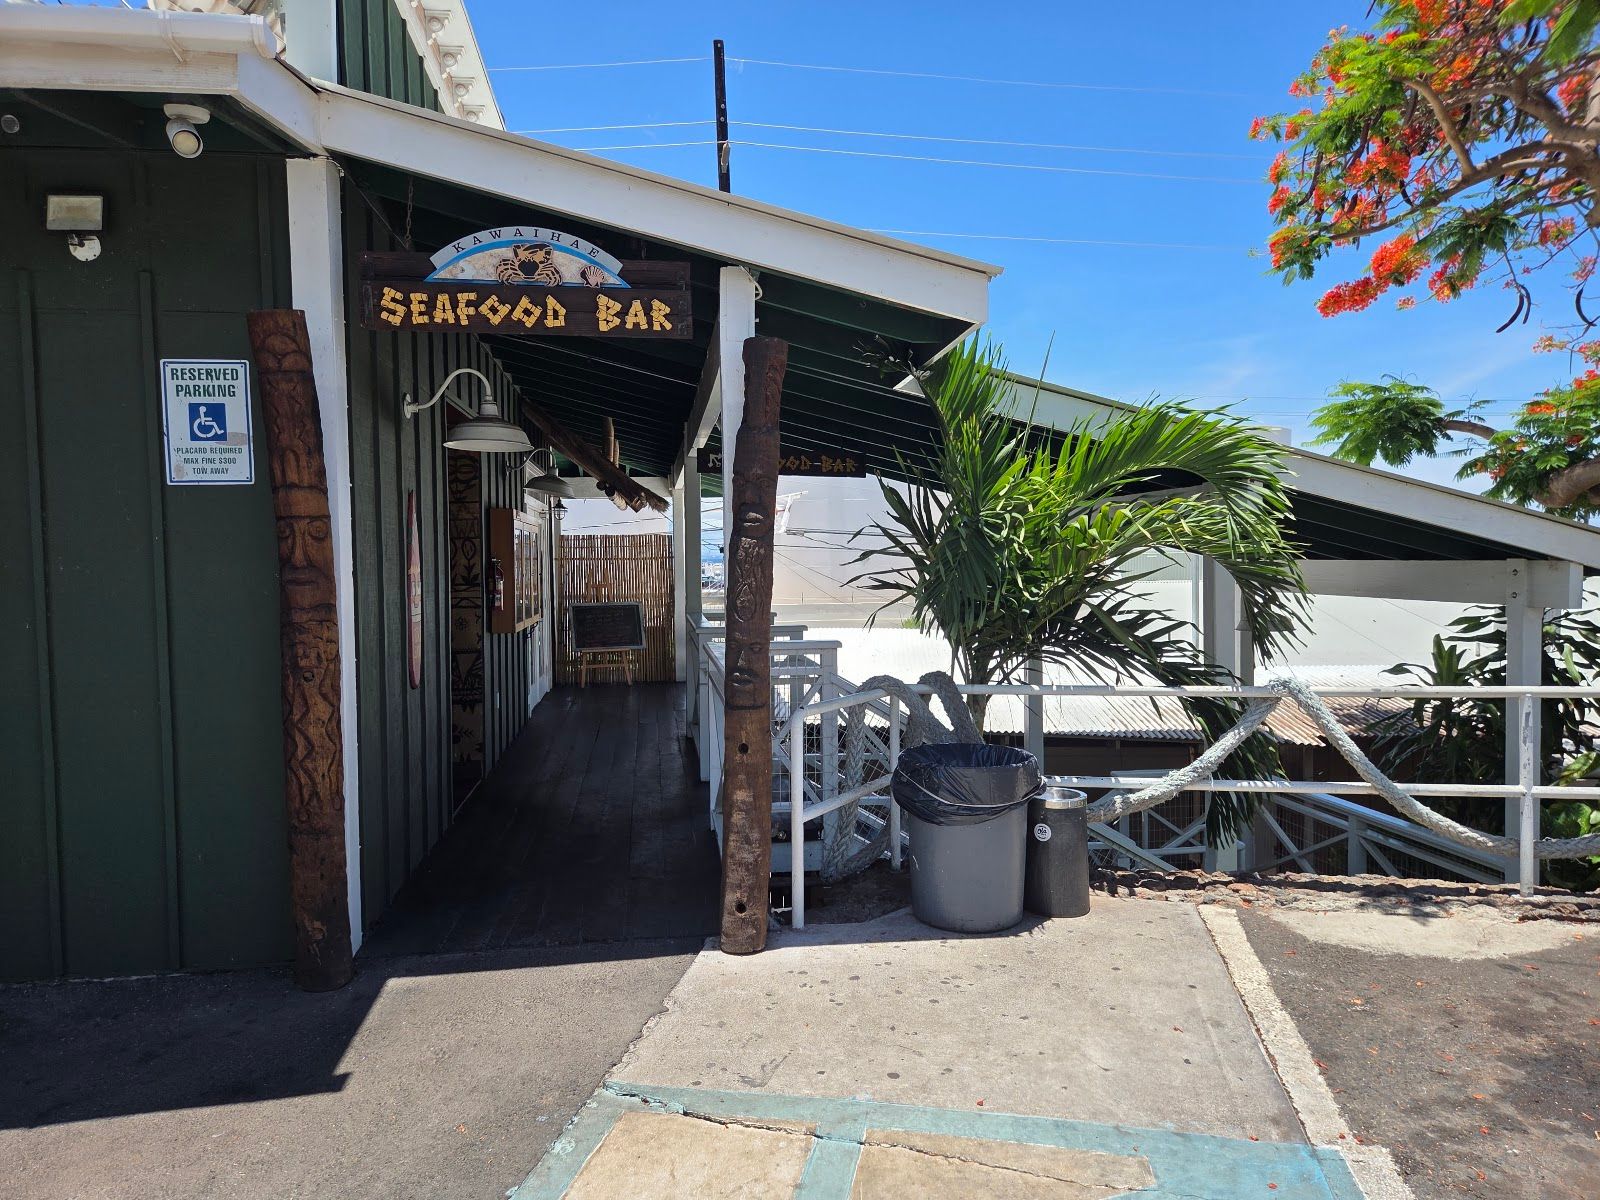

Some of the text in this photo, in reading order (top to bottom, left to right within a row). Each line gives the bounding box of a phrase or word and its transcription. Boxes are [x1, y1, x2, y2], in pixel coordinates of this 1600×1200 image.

[452, 227, 600, 258] KAWAIHAE
[380, 286, 673, 332] SEAFOOD BAR
[170, 367, 240, 381] RESERVED
[175, 384, 237, 398] PARKING
[209, 447, 243, 455] REQUIRED
[183, 457, 237, 465] MAX FINE $300
[820, 455, 856, 473] BAR
[192, 467, 229, 475] TOW AWAY
